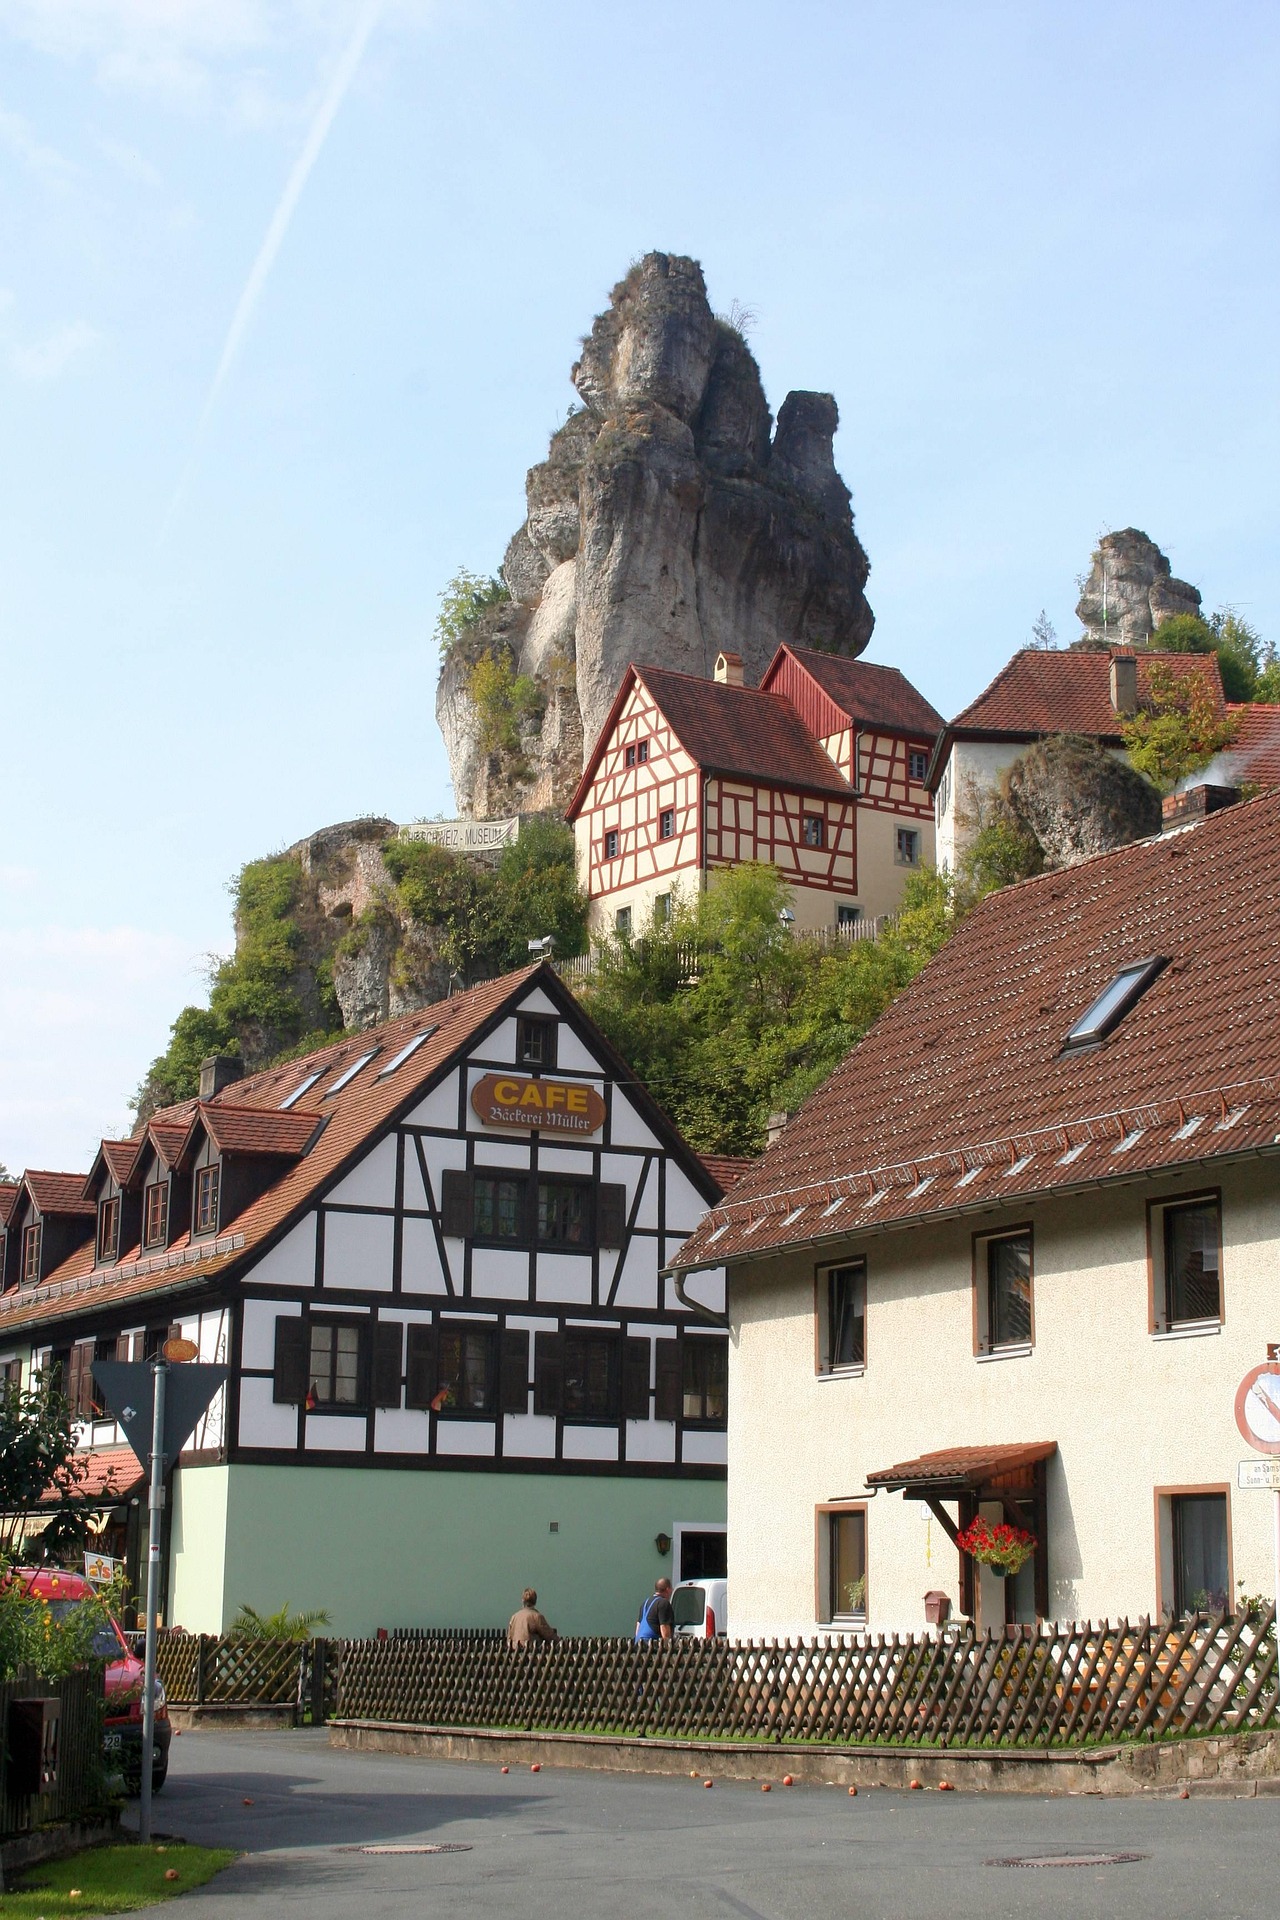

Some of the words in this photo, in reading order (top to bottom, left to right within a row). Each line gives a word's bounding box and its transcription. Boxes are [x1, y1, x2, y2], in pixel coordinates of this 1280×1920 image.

[465, 828, 502, 845] MUSEUM
[493, 1081, 588, 1112] CAFE
[490, 1107, 542, 1125] Bäckerei
[546, 1112, 591, 1130] Müller
[1262, 1464, 1280, 1474] Sams
